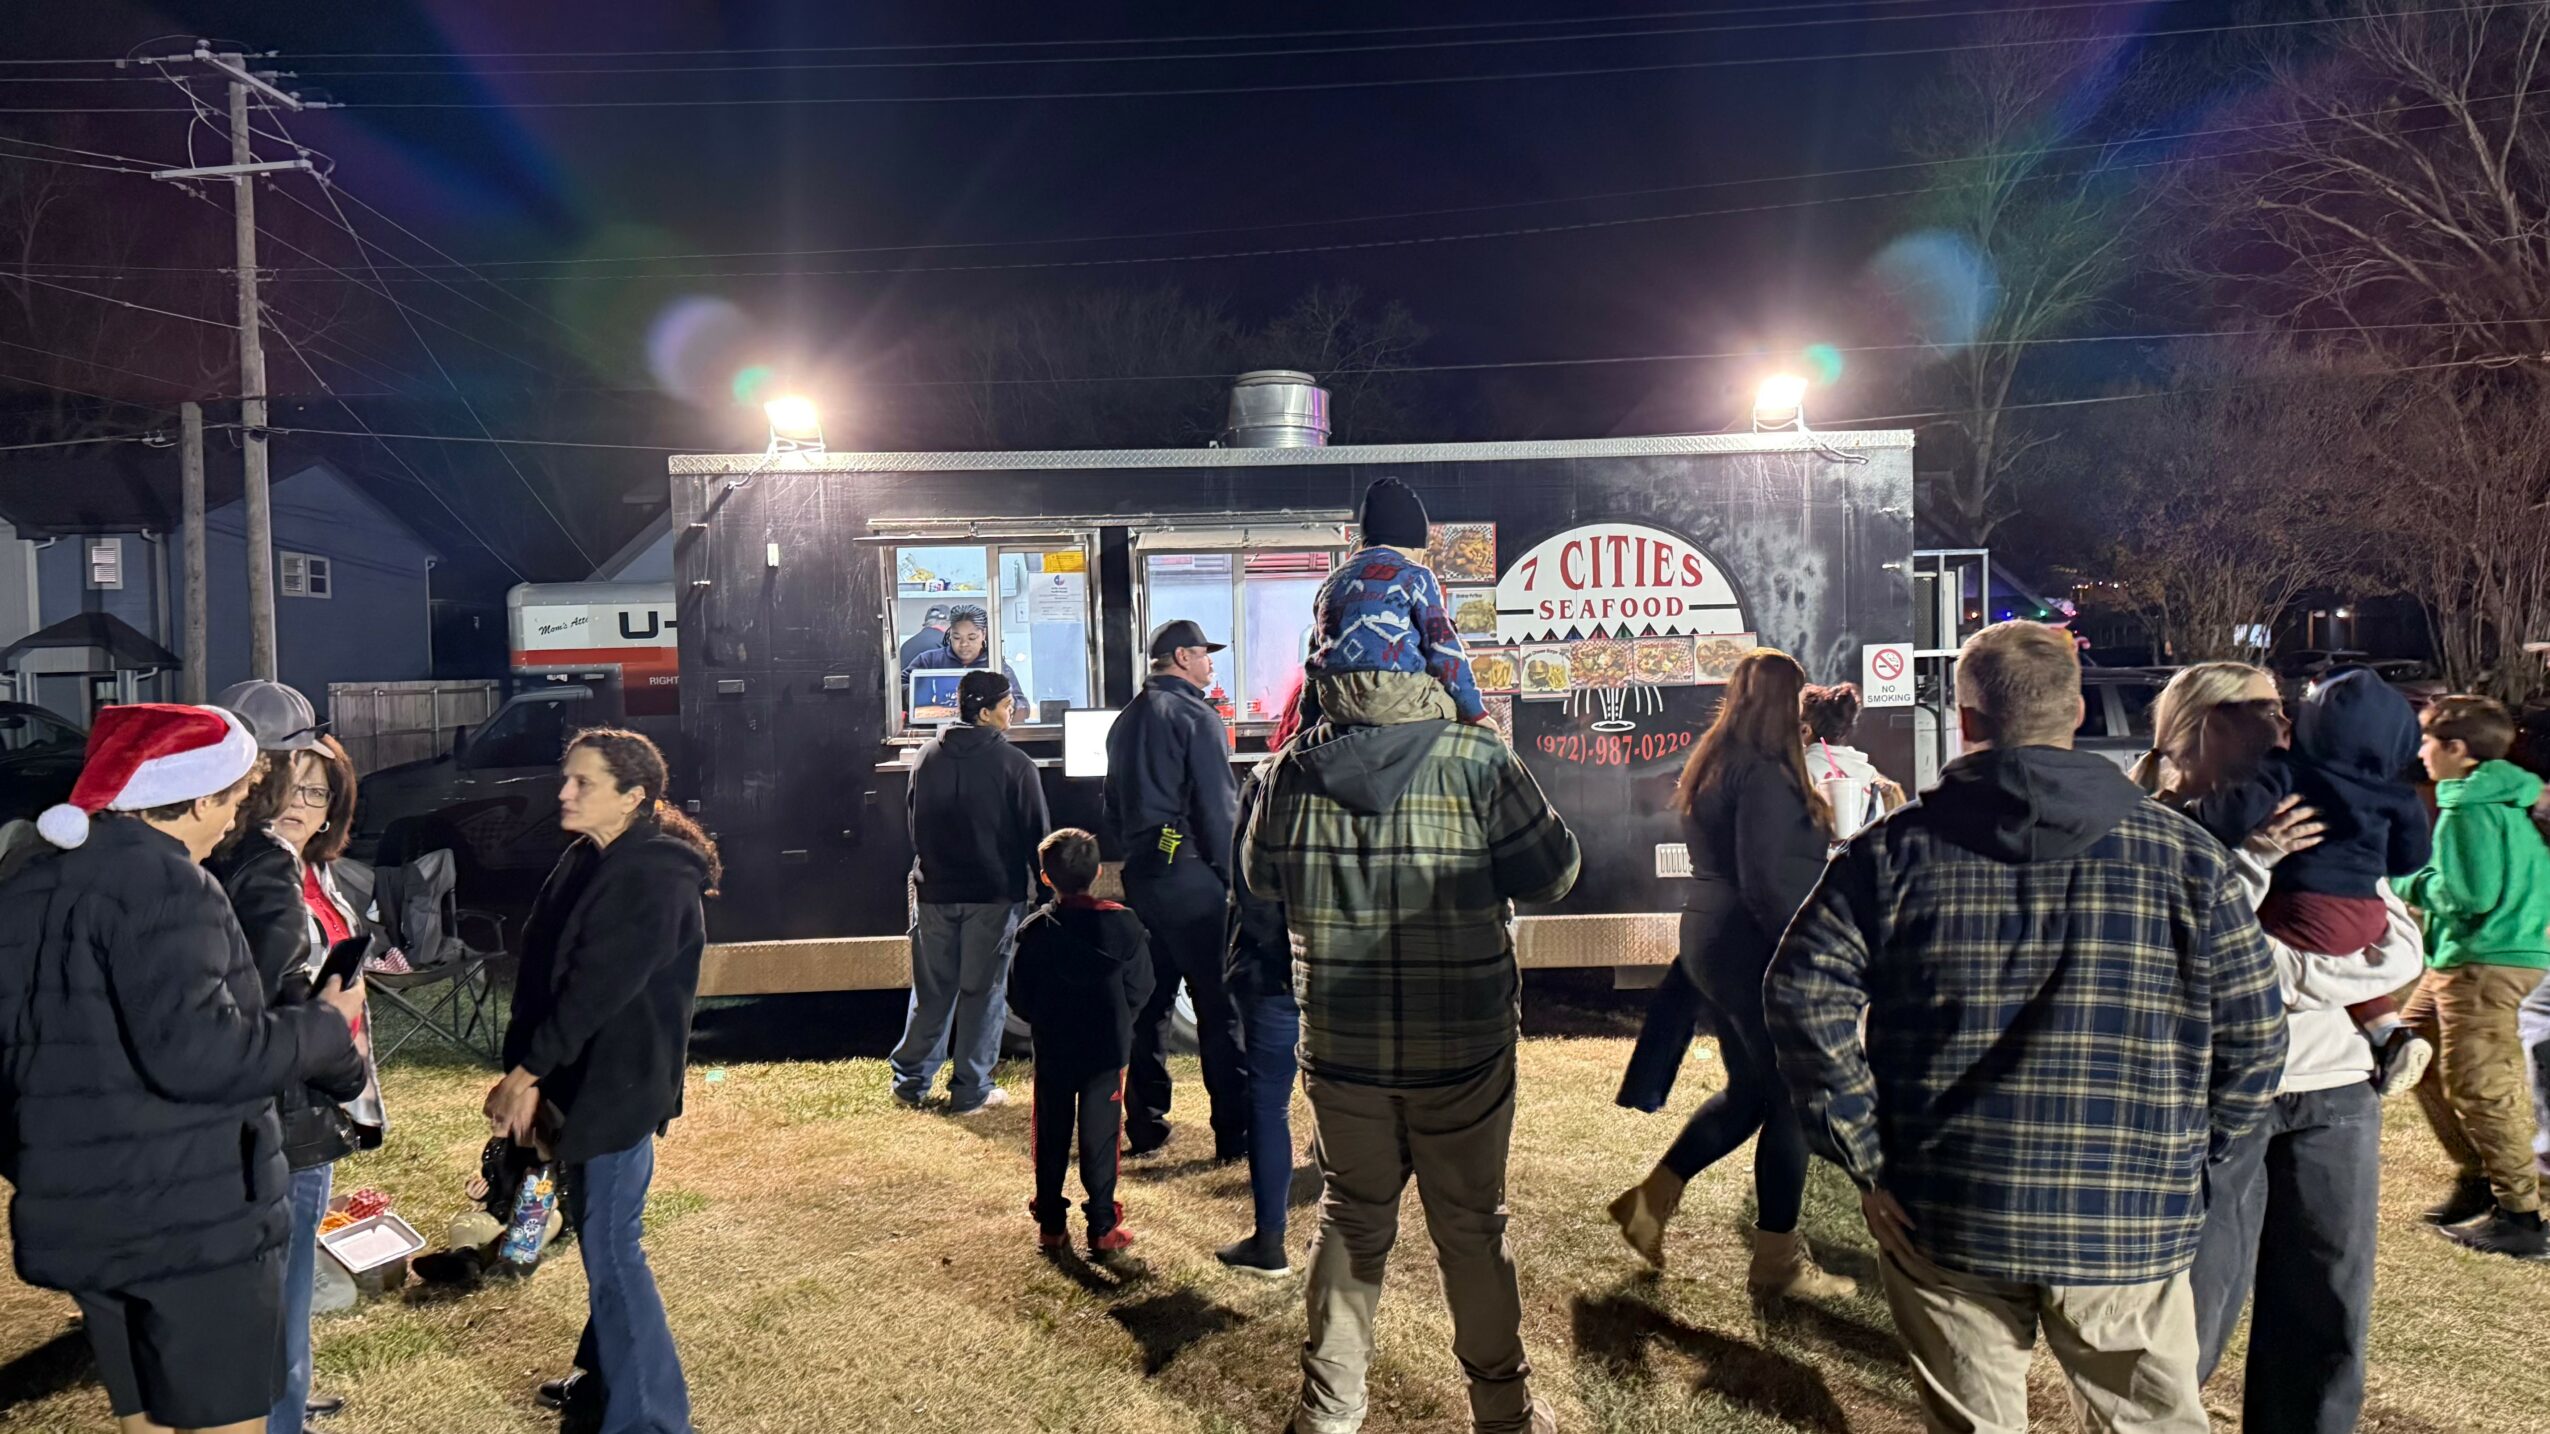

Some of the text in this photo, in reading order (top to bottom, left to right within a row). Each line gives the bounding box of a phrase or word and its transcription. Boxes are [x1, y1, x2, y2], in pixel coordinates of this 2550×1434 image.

[1520, 534, 1704, 592] 7 CITIES
[1538, 596, 1684, 620] SEAFOOD
[538, 622, 568, 636] Mom's
[648, 675, 680, 686] RIGHT
[1881, 685, 1896, 693] NO
[1867, 693, 1911, 703] SMOKING
[1536, 731, 1693, 766] (972)-987-0220
